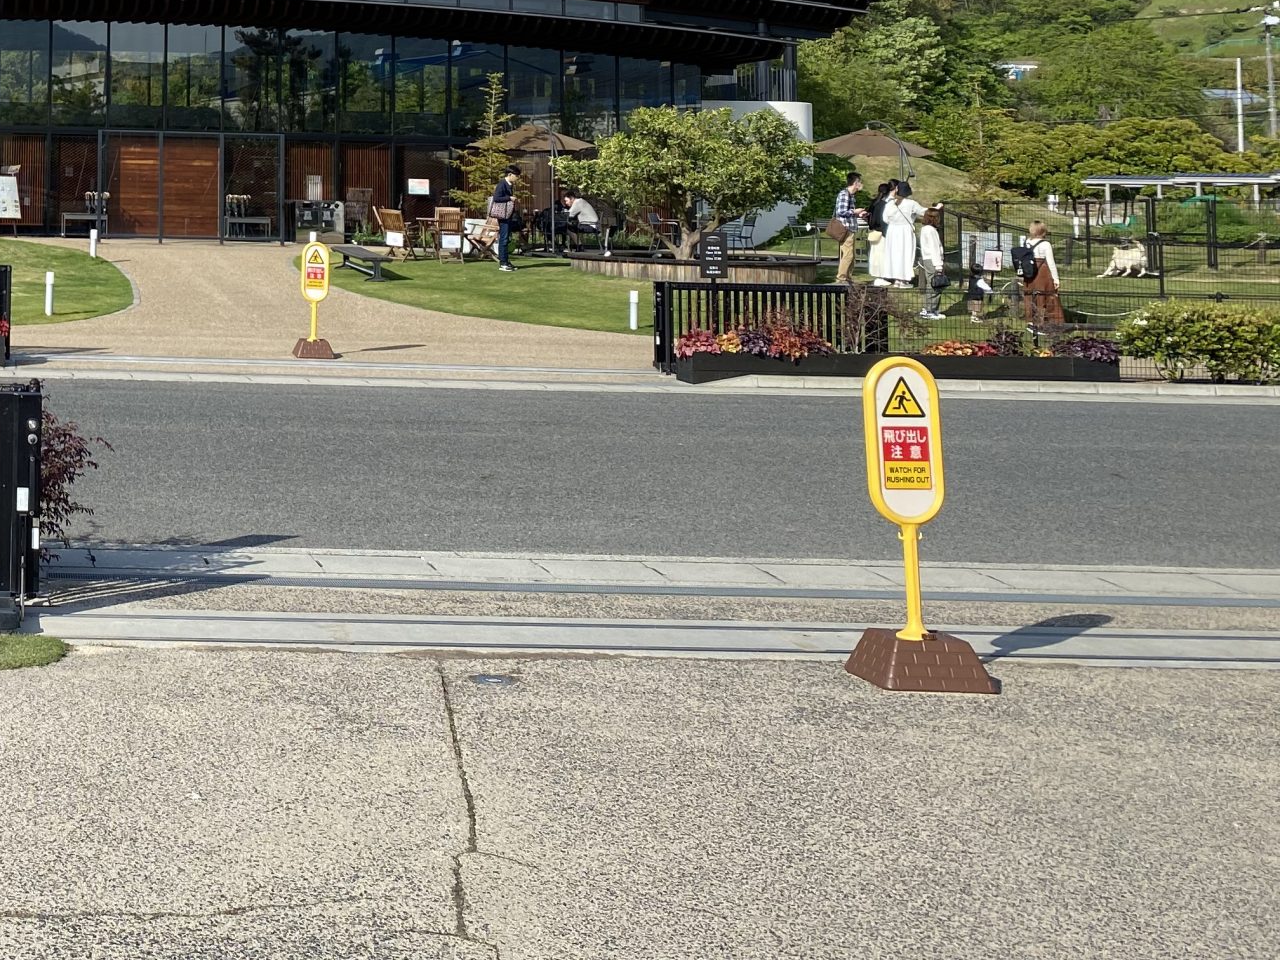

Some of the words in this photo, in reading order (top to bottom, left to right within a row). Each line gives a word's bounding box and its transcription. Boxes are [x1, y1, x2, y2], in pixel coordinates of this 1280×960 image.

[883, 429, 927, 443] 飛び出し
[891, 445, 922, 459] 注意
